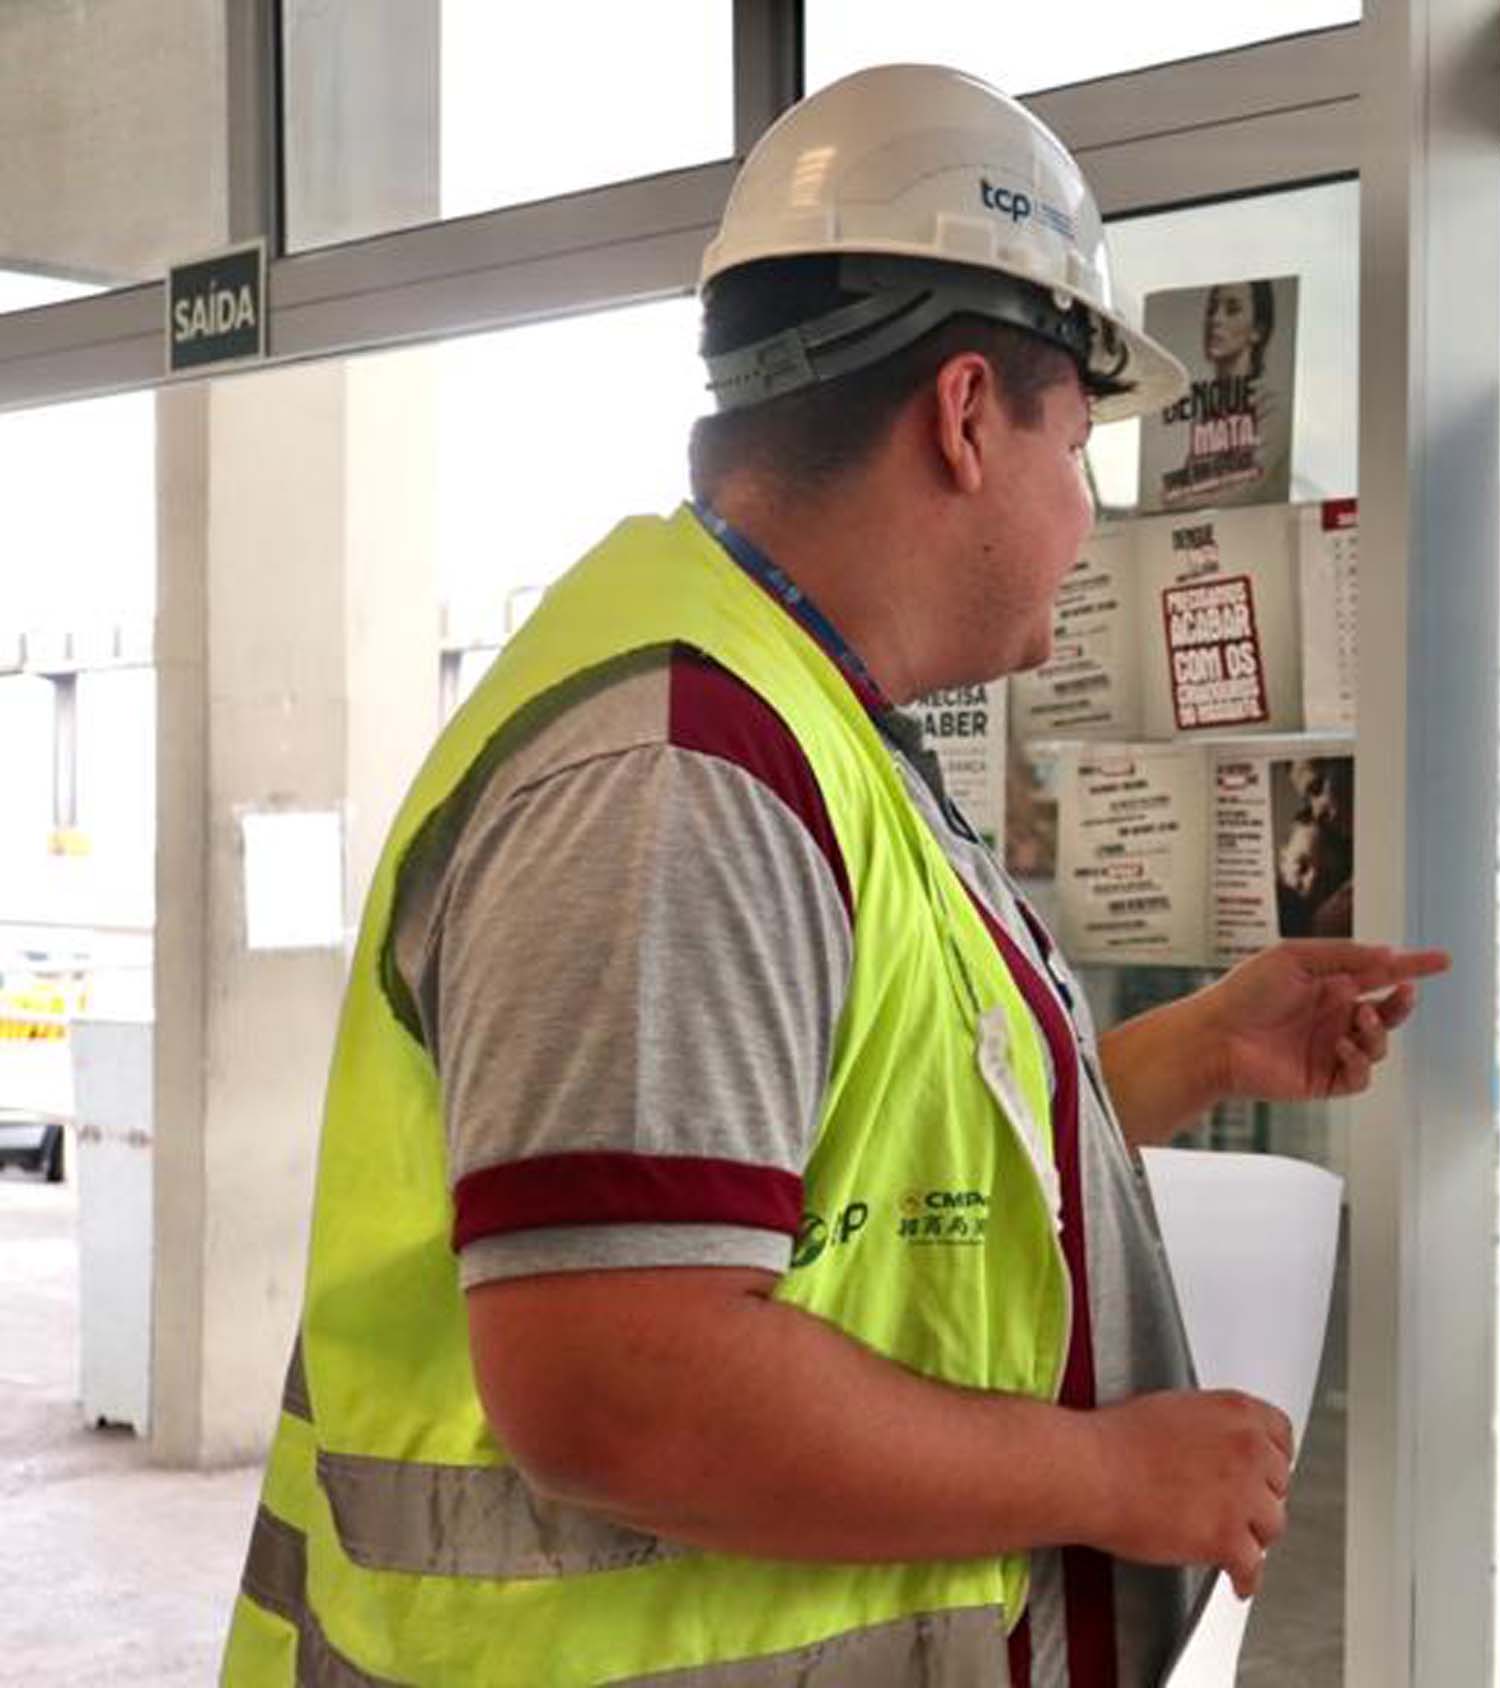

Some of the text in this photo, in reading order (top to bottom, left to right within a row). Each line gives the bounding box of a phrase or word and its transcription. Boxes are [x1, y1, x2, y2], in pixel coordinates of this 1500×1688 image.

[980, 177, 1031, 223] tcp
[175, 279, 255, 343] SAÍDA
[1170, 603, 1251, 650] ACABAR
[1173, 640, 1257, 685] COM OS
[925, 710, 988, 738] ABER
